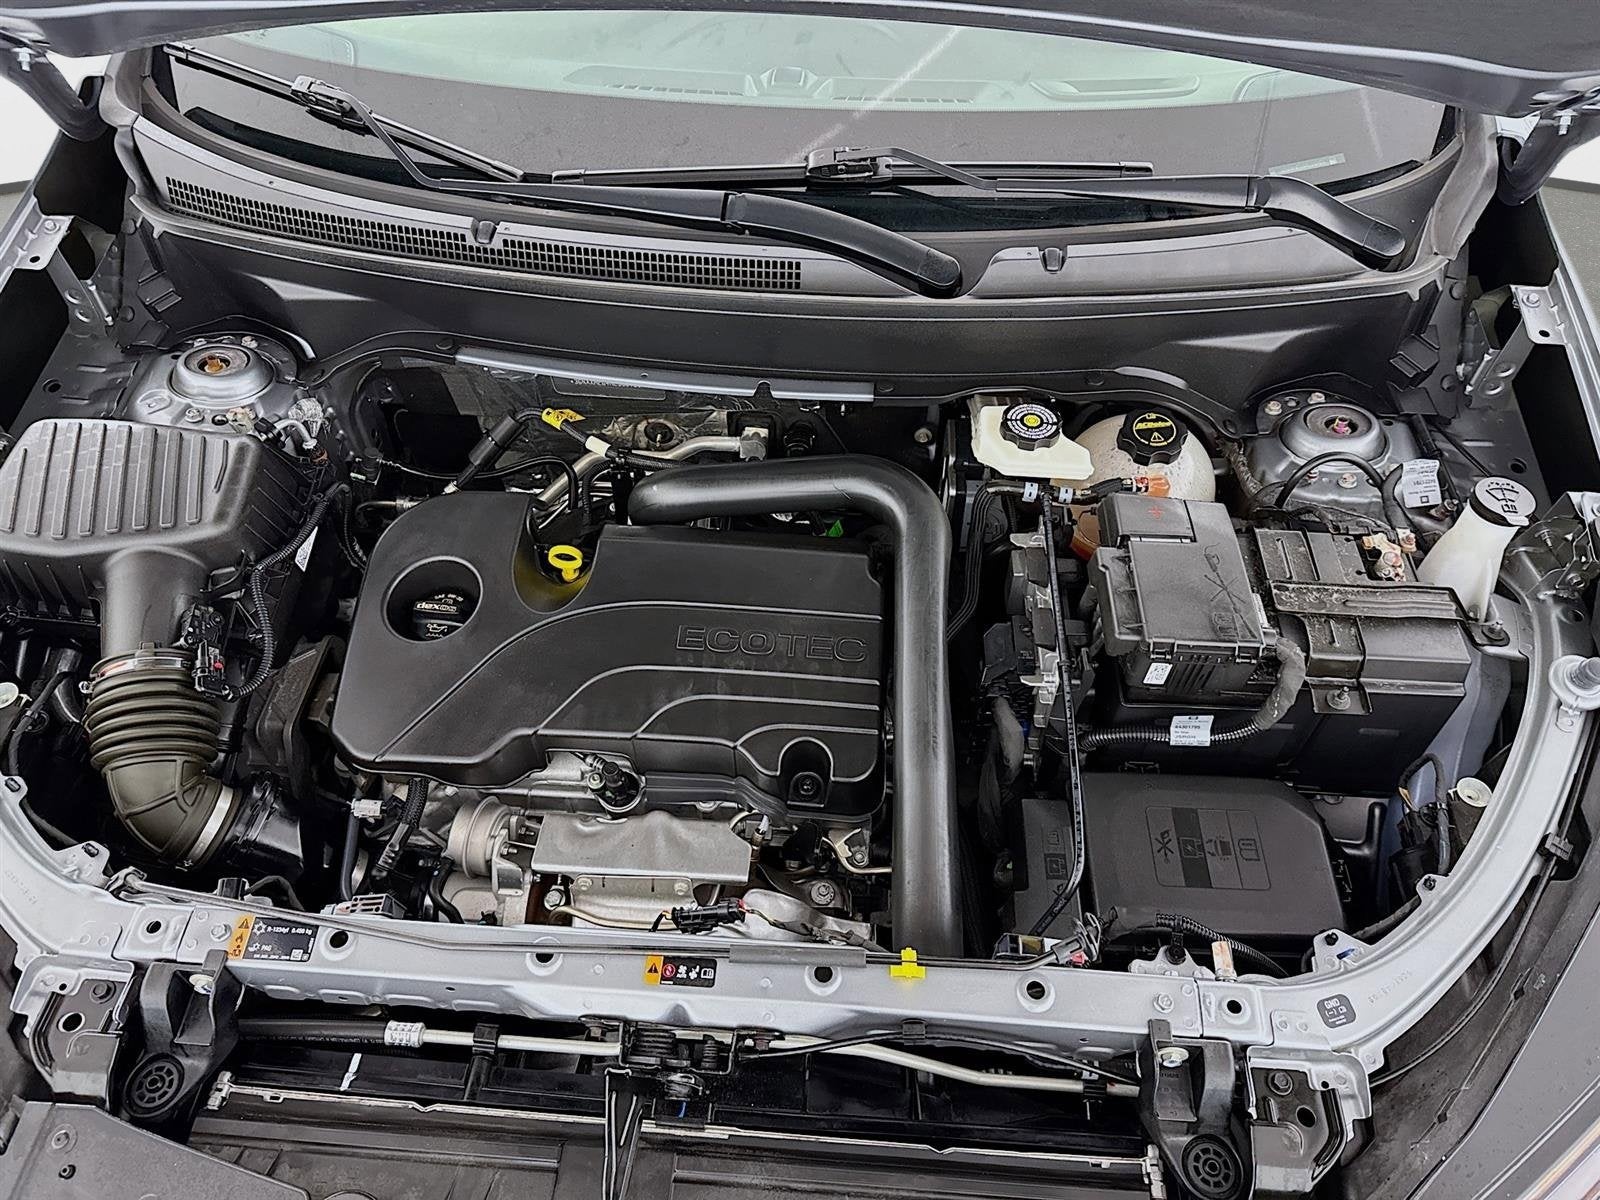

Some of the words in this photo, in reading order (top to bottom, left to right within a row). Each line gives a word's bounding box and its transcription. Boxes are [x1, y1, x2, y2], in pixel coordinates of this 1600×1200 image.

[416, 602, 457, 613] dexos
[676, 624, 867, 662] ECOTEC
[1324, 998, 1340, 1010] GND
